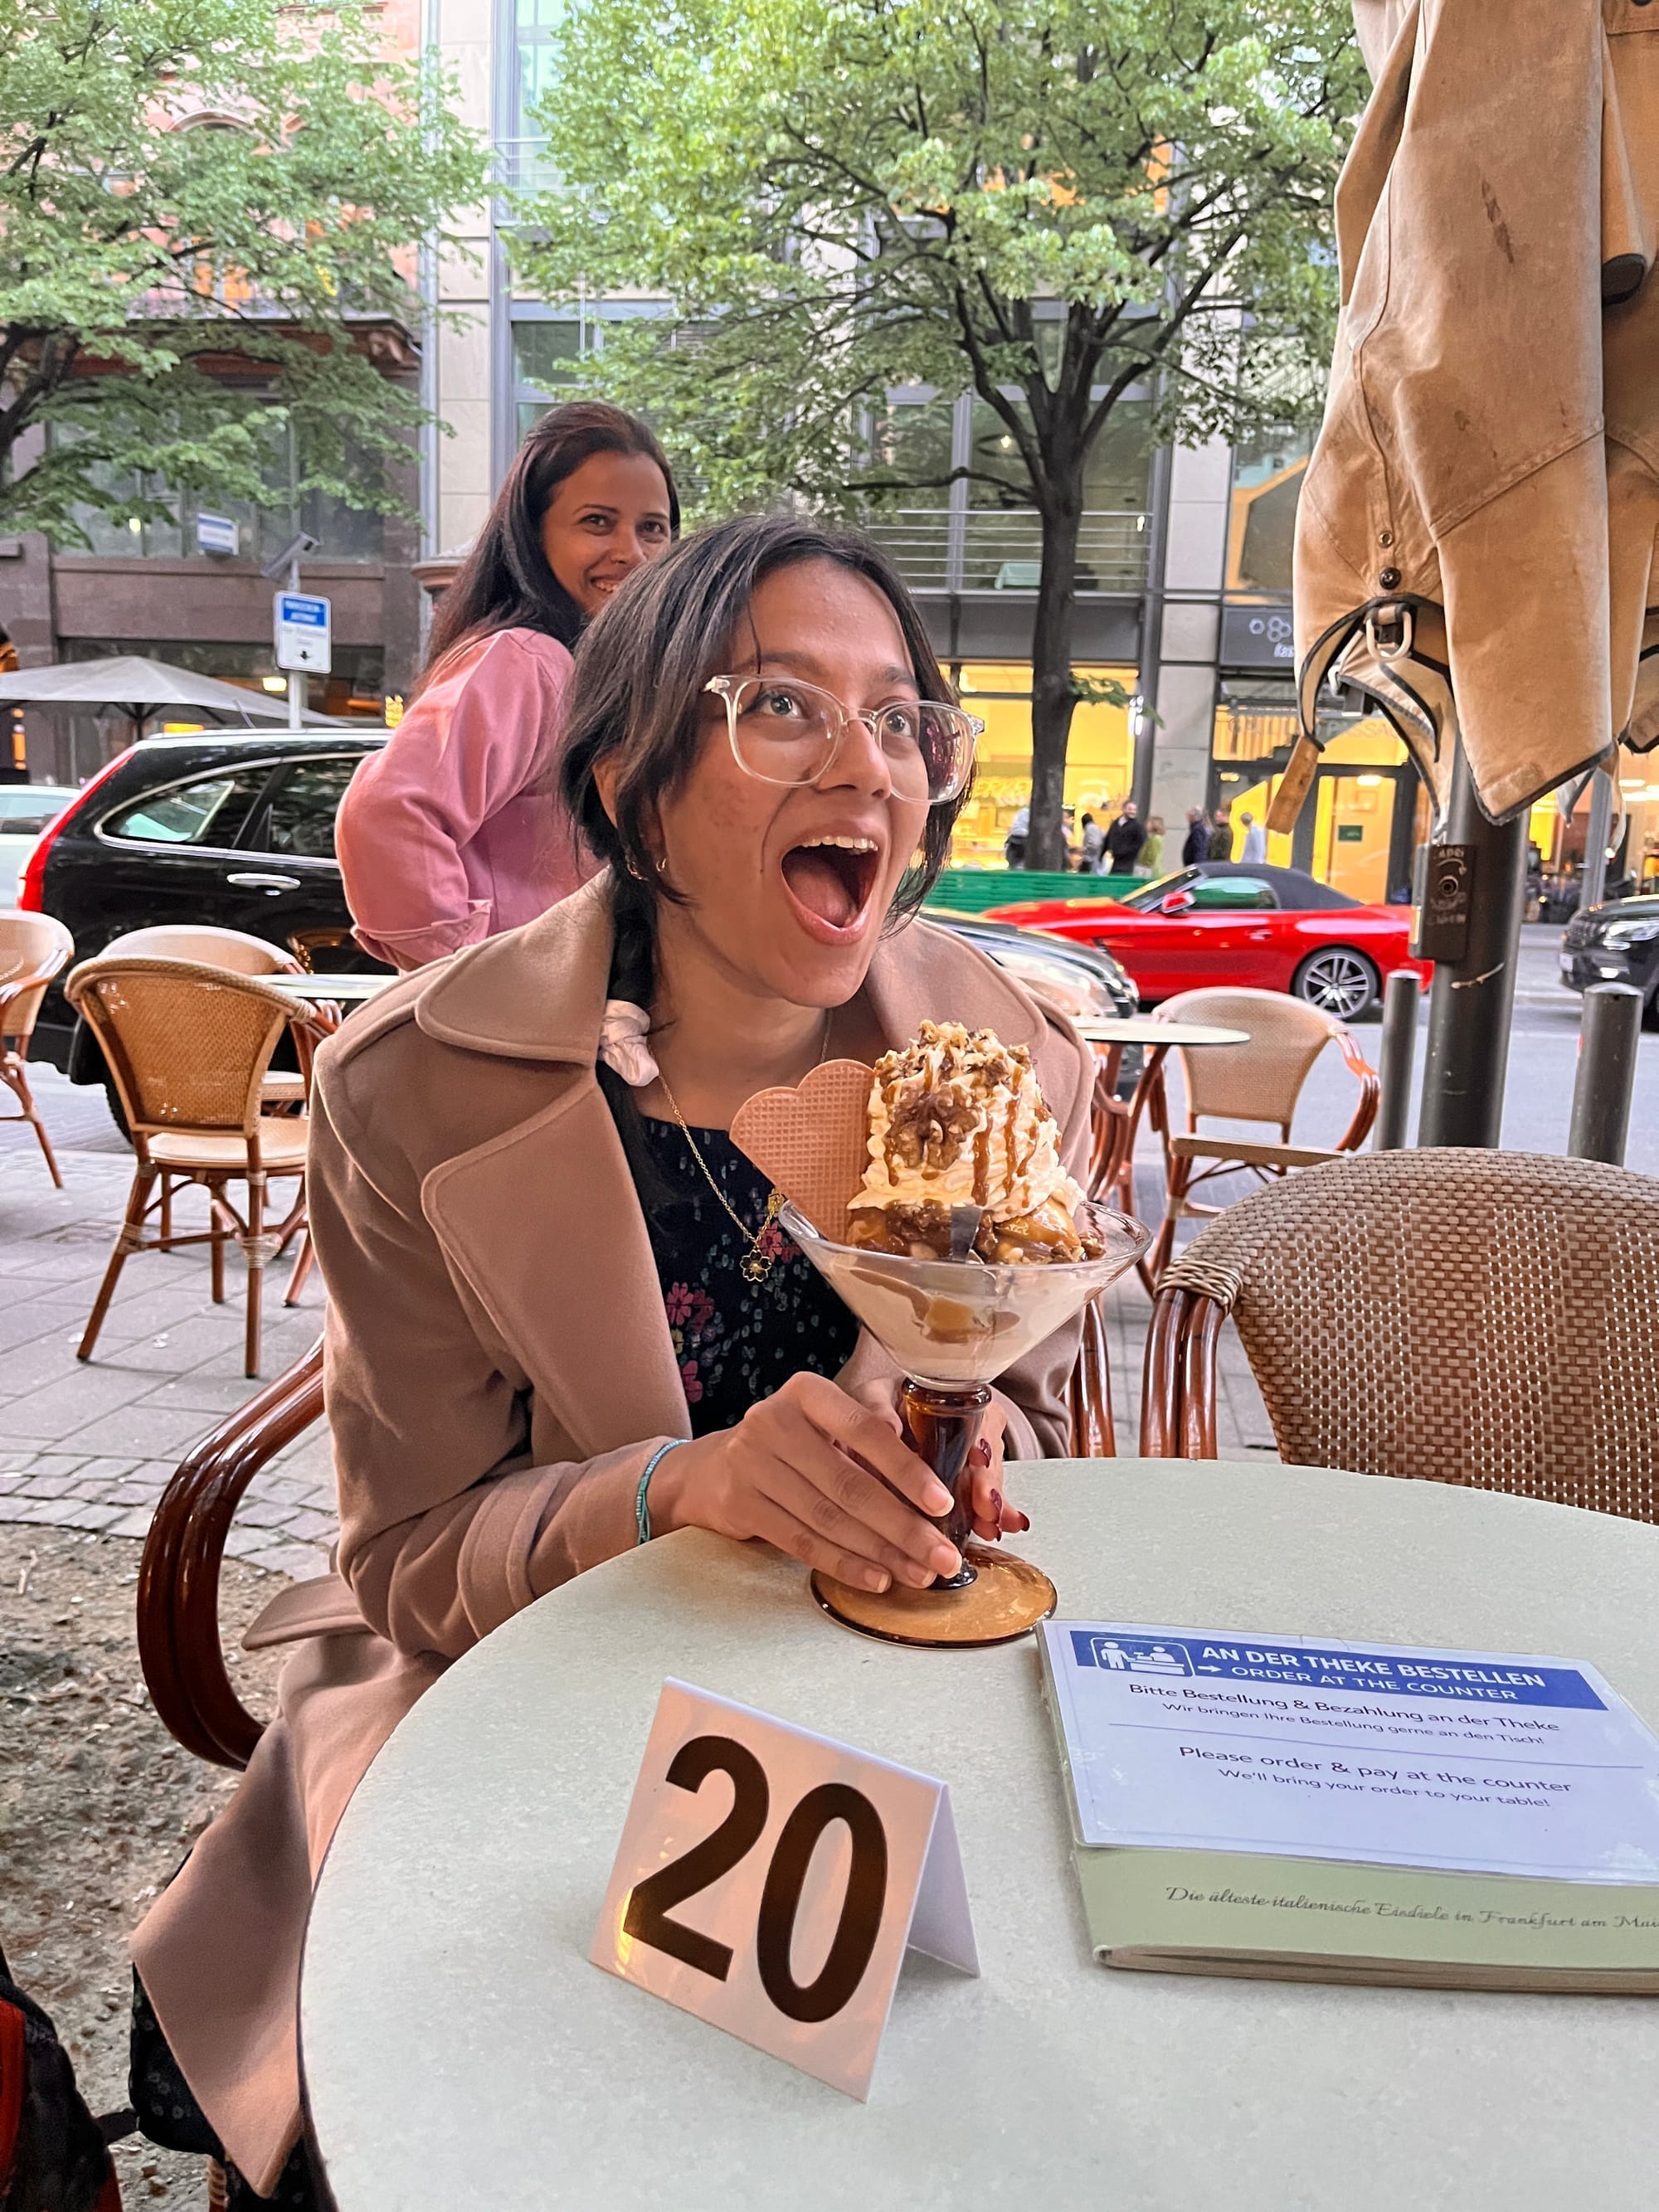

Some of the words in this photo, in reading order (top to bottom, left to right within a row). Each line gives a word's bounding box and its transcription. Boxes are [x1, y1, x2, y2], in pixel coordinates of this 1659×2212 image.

[1202, 1646, 1240, 1661] AN
[1246, 1650, 1299, 1667] DER
[1303, 1656, 1393, 1675] THEKE
[1399, 1664, 1546, 1687] BESTELLEN
[1231, 1666, 1312, 1683] ORDER
[1320, 1675, 1345, 1685] AT
[1351, 1677, 1401, 1690] THE
[1406, 1683, 1519, 1699] COUNTER
[1129, 1684, 1178, 1698] Bitte
[1183, 1689, 1288, 1710] Bestellung
[1293, 1699, 1311, 1711] &
[1315, 1701, 1423, 1723] Bezahlung
[1428, 1713, 1453, 1723] an
[1457, 1714, 1491, 1726] der
[1493, 1717, 1560, 1732] Theke
[1162, 1703, 1194, 1712] Wir
[1198, 1706, 1259, 1719] bringen
[1264, 1713, 1296, 1723] Ihre
[1300, 1716, 1384, 1733] Bestellung
[1388, 1725, 1433, 1734] gerne
[1438, 1729, 1459, 1738] an
[1463, 1731, 1494, 1740] den
[1497, 1734, 1545, 1745] Tisch!
[1179, 1746, 1253, 1763] Please
[1260, 1757, 1322, 1771] order
[1331, 1762, 1351, 1774] &
[1357, 1767, 1399, 1780] pay
[1407, 1771, 1431, 1782] at
[1437, 1772, 1477, 1785] the
[1482, 1777, 1572, 1792] counter
[1218, 1768, 1267, 1782] We'll
[1272, 1774, 1321, 1789] bring
[1325, 1782, 1366, 1792] your
[1370, 1785, 1418, 1796] order
[1424, 1790, 1446, 1799] to
[1451, 1792, 1492, 1802] your
[1497, 1796, 1550, 1807] table!
[623, 1735, 888, 2023] 20
[1165, 1886, 1204, 1903] Die
[1209, 1889, 1269, 1906] älteste
[1272, 1894, 1372, 1915] italienische
[1374, 1903, 1450, 1919] Eisdiele
[1454, 1911, 1474, 1923] in
[1479, 1910, 1576, 1930] Frankfurt
[1580, 1919, 1608, 1928] am
[1614, 1914, 1659, 1928] Mai
